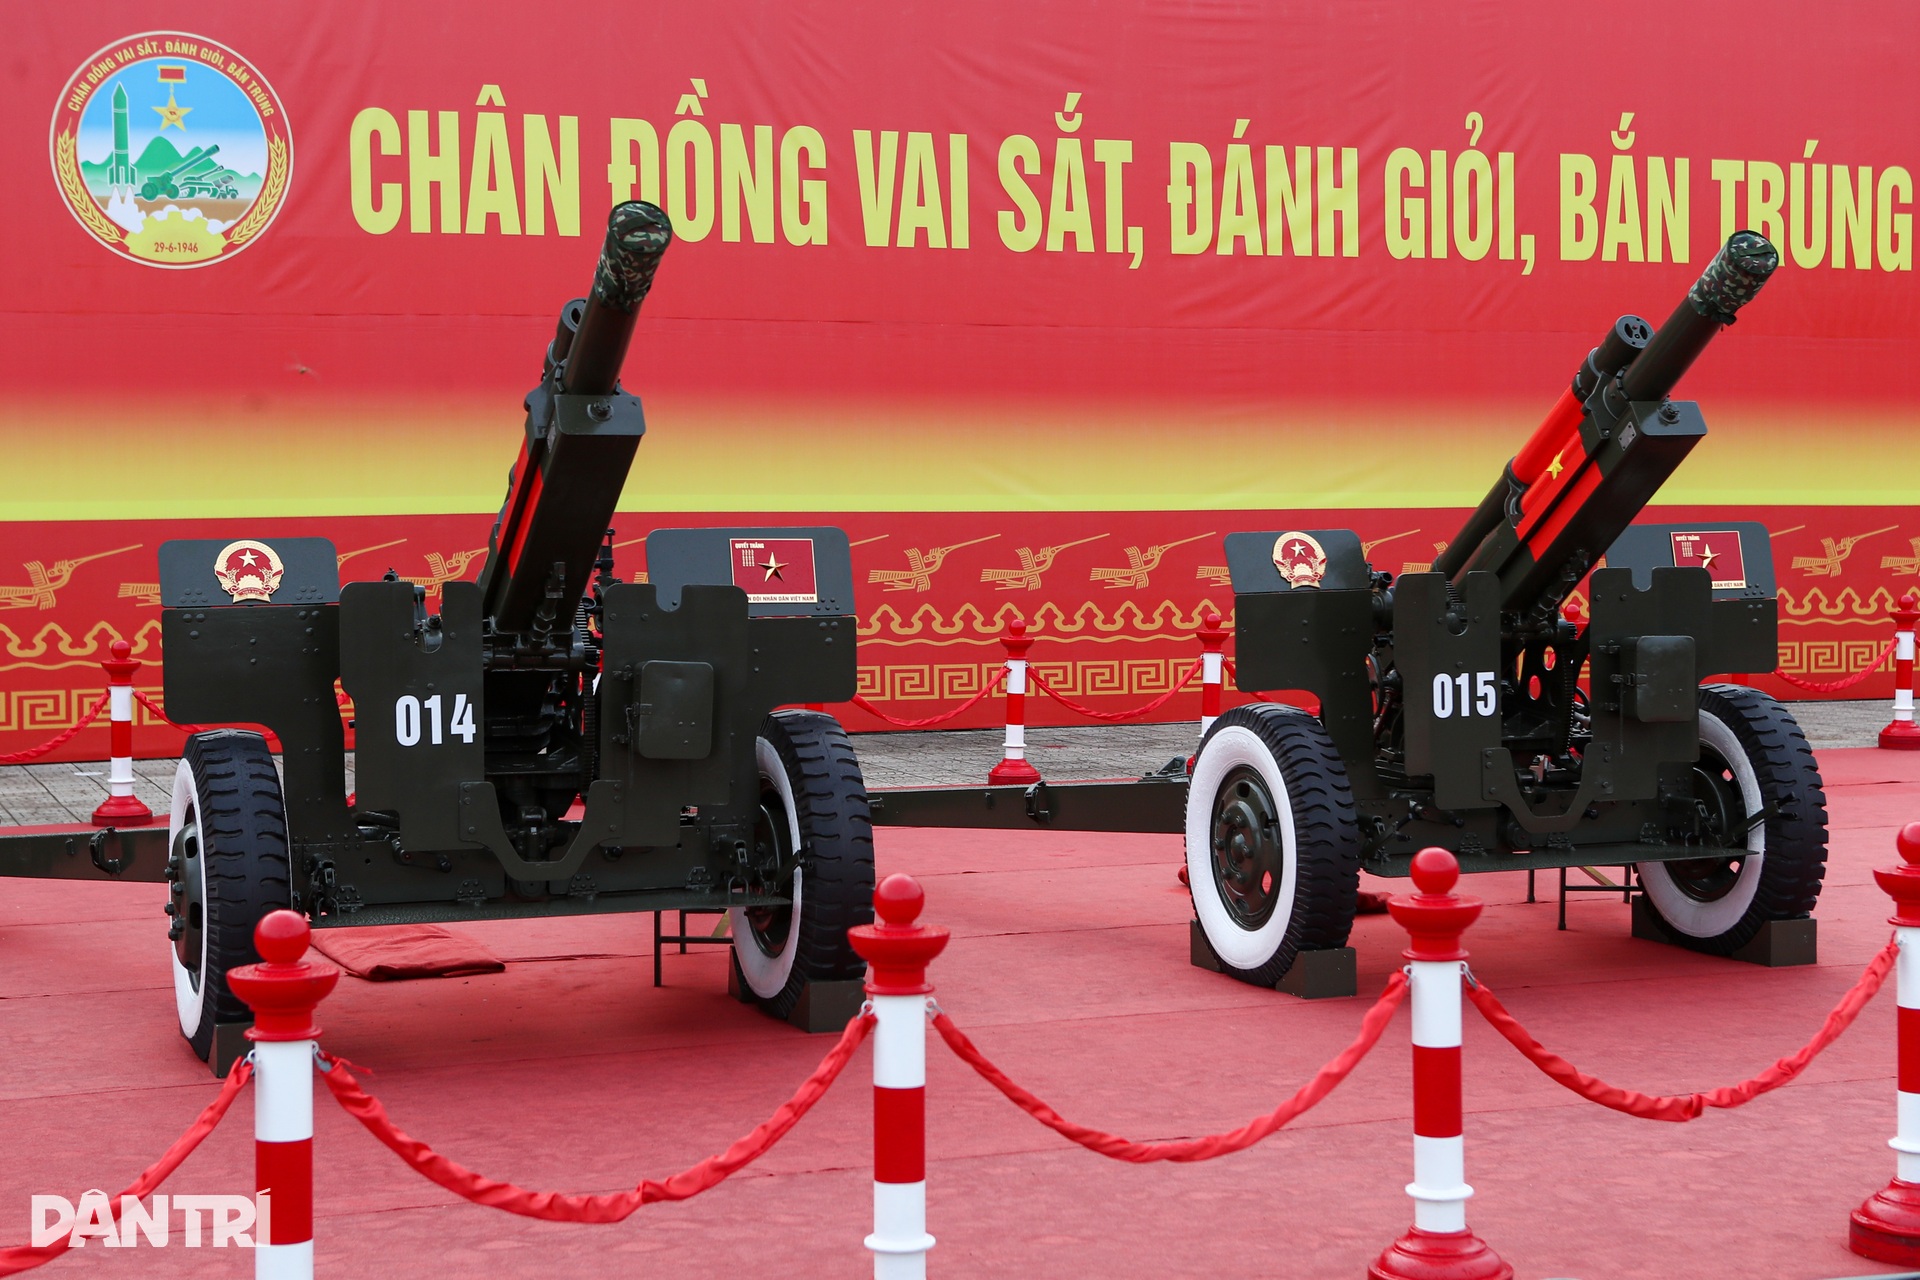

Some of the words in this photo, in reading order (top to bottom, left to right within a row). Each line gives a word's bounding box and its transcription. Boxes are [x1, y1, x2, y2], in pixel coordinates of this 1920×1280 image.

[67, 81, 92, 112] CHÂN
[114, 47, 136, 63] VAI
[165, 39, 198, 56] ĐÁNH
[246, 80, 275, 117] TRÚNG
[350, 84, 580, 237] CHÂN
[608, 78, 827, 247] ĐỒNG
[853, 129, 970, 249] VAI
[997, 92, 1144, 269] SẮT,
[1167, 119, 1359, 258] ĐÁNH
[1384, 112, 1535, 275] GIỎI,
[1559, 112, 1690, 264] BẮN
[1711, 139, 1913, 273] TRÚNG
[154, 242, 199, 254] 29-6-1946
[395, 693, 477, 747] 014
[1432, 671, 1497, 719] 015
